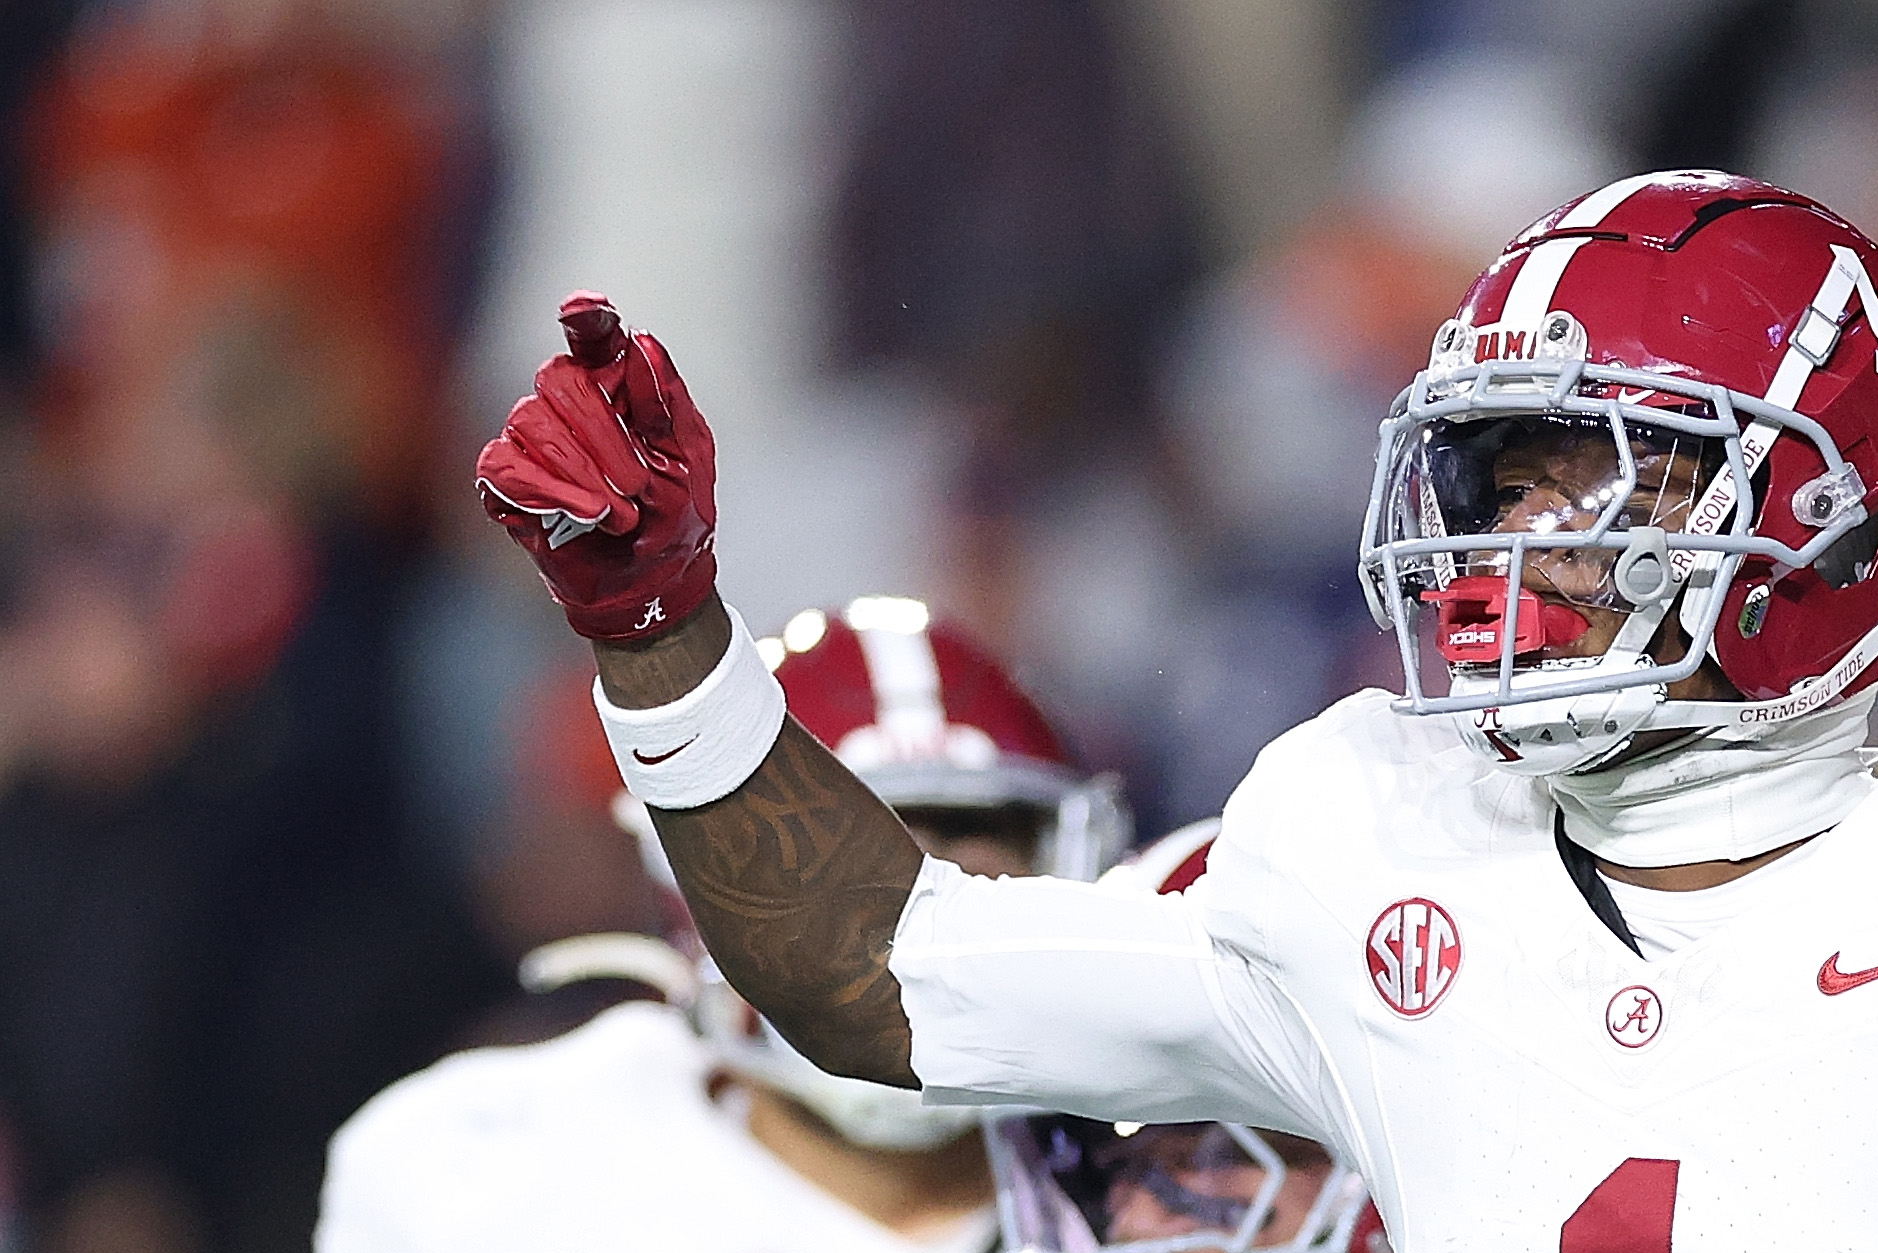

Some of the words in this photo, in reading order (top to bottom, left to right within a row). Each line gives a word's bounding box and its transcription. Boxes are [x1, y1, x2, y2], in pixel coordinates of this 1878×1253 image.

[634, 597, 666, 631] A
[1740, 679, 1831, 723] CRIMSON
[1835, 652, 1865, 688] TIDE
[1369, 902, 1458, 1010] SEC
[1613, 995, 1652, 1033] A
